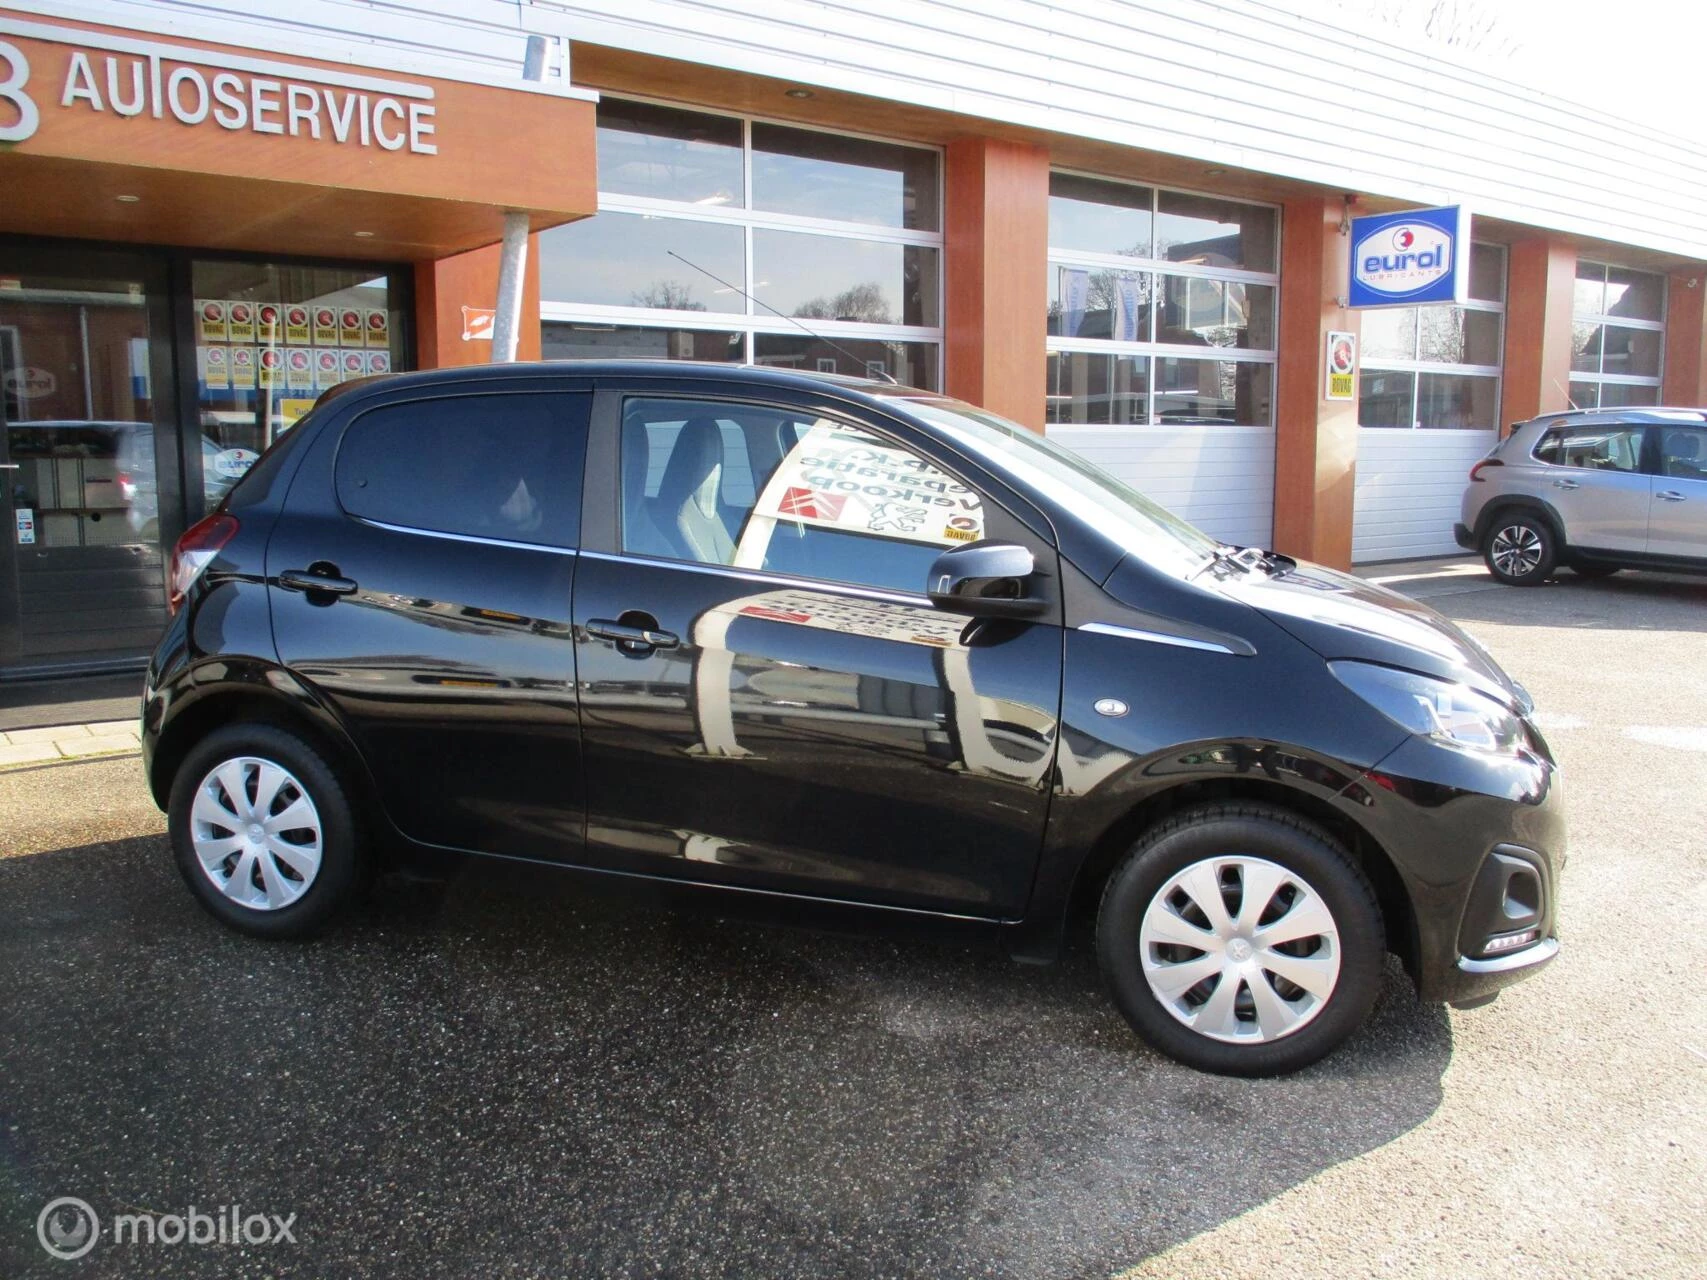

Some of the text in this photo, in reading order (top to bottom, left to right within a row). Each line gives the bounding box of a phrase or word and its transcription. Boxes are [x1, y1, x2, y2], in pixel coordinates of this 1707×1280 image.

[61, 51, 438, 155] AUTOSERVICE
[1364, 243, 1443, 273] eurol
[1362, 270, 1442, 281] LUBRICANTS
[1332, 377, 1352, 393] BOVAG
